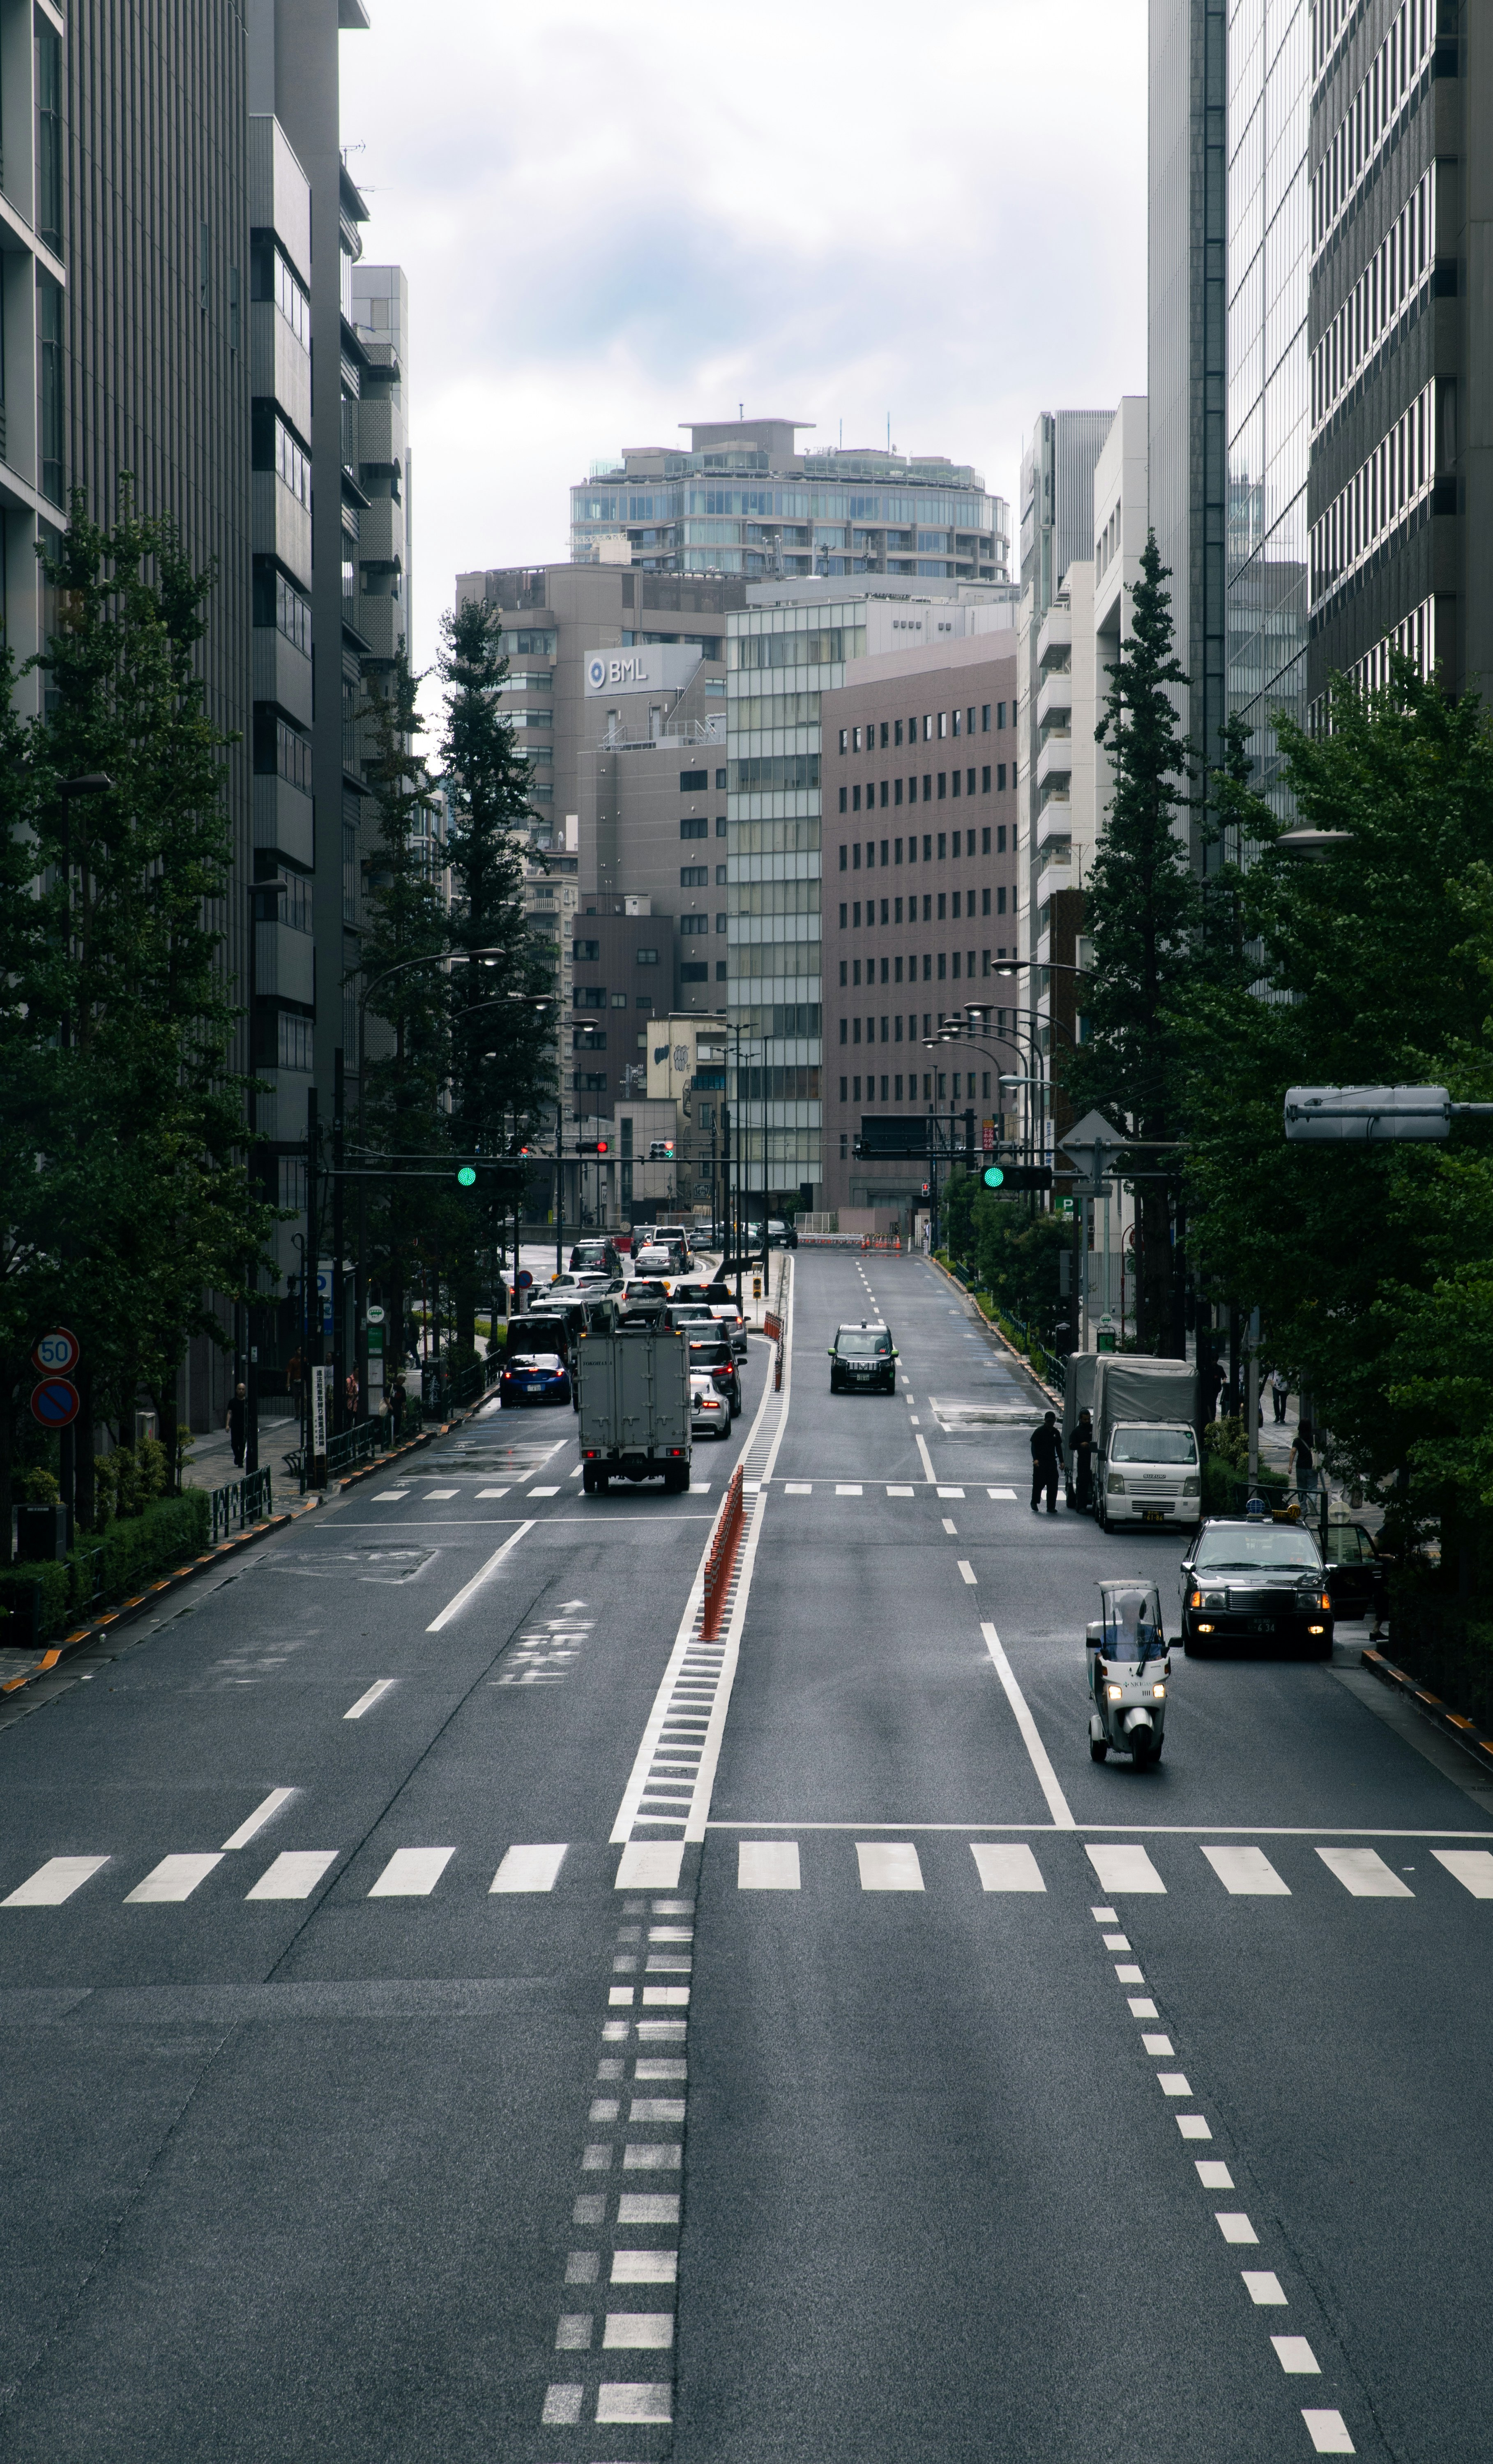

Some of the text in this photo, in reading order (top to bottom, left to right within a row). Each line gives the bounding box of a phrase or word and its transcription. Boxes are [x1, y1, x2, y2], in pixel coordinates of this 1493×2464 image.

[610, 658, 647, 682] BML
[1063, 1199, 1074, 1210] P
[42, 1341, 68, 1362] 50
[1288, 1507, 1300, 1517] 370
[486, 1617, 599, 1685] 右折禁止
